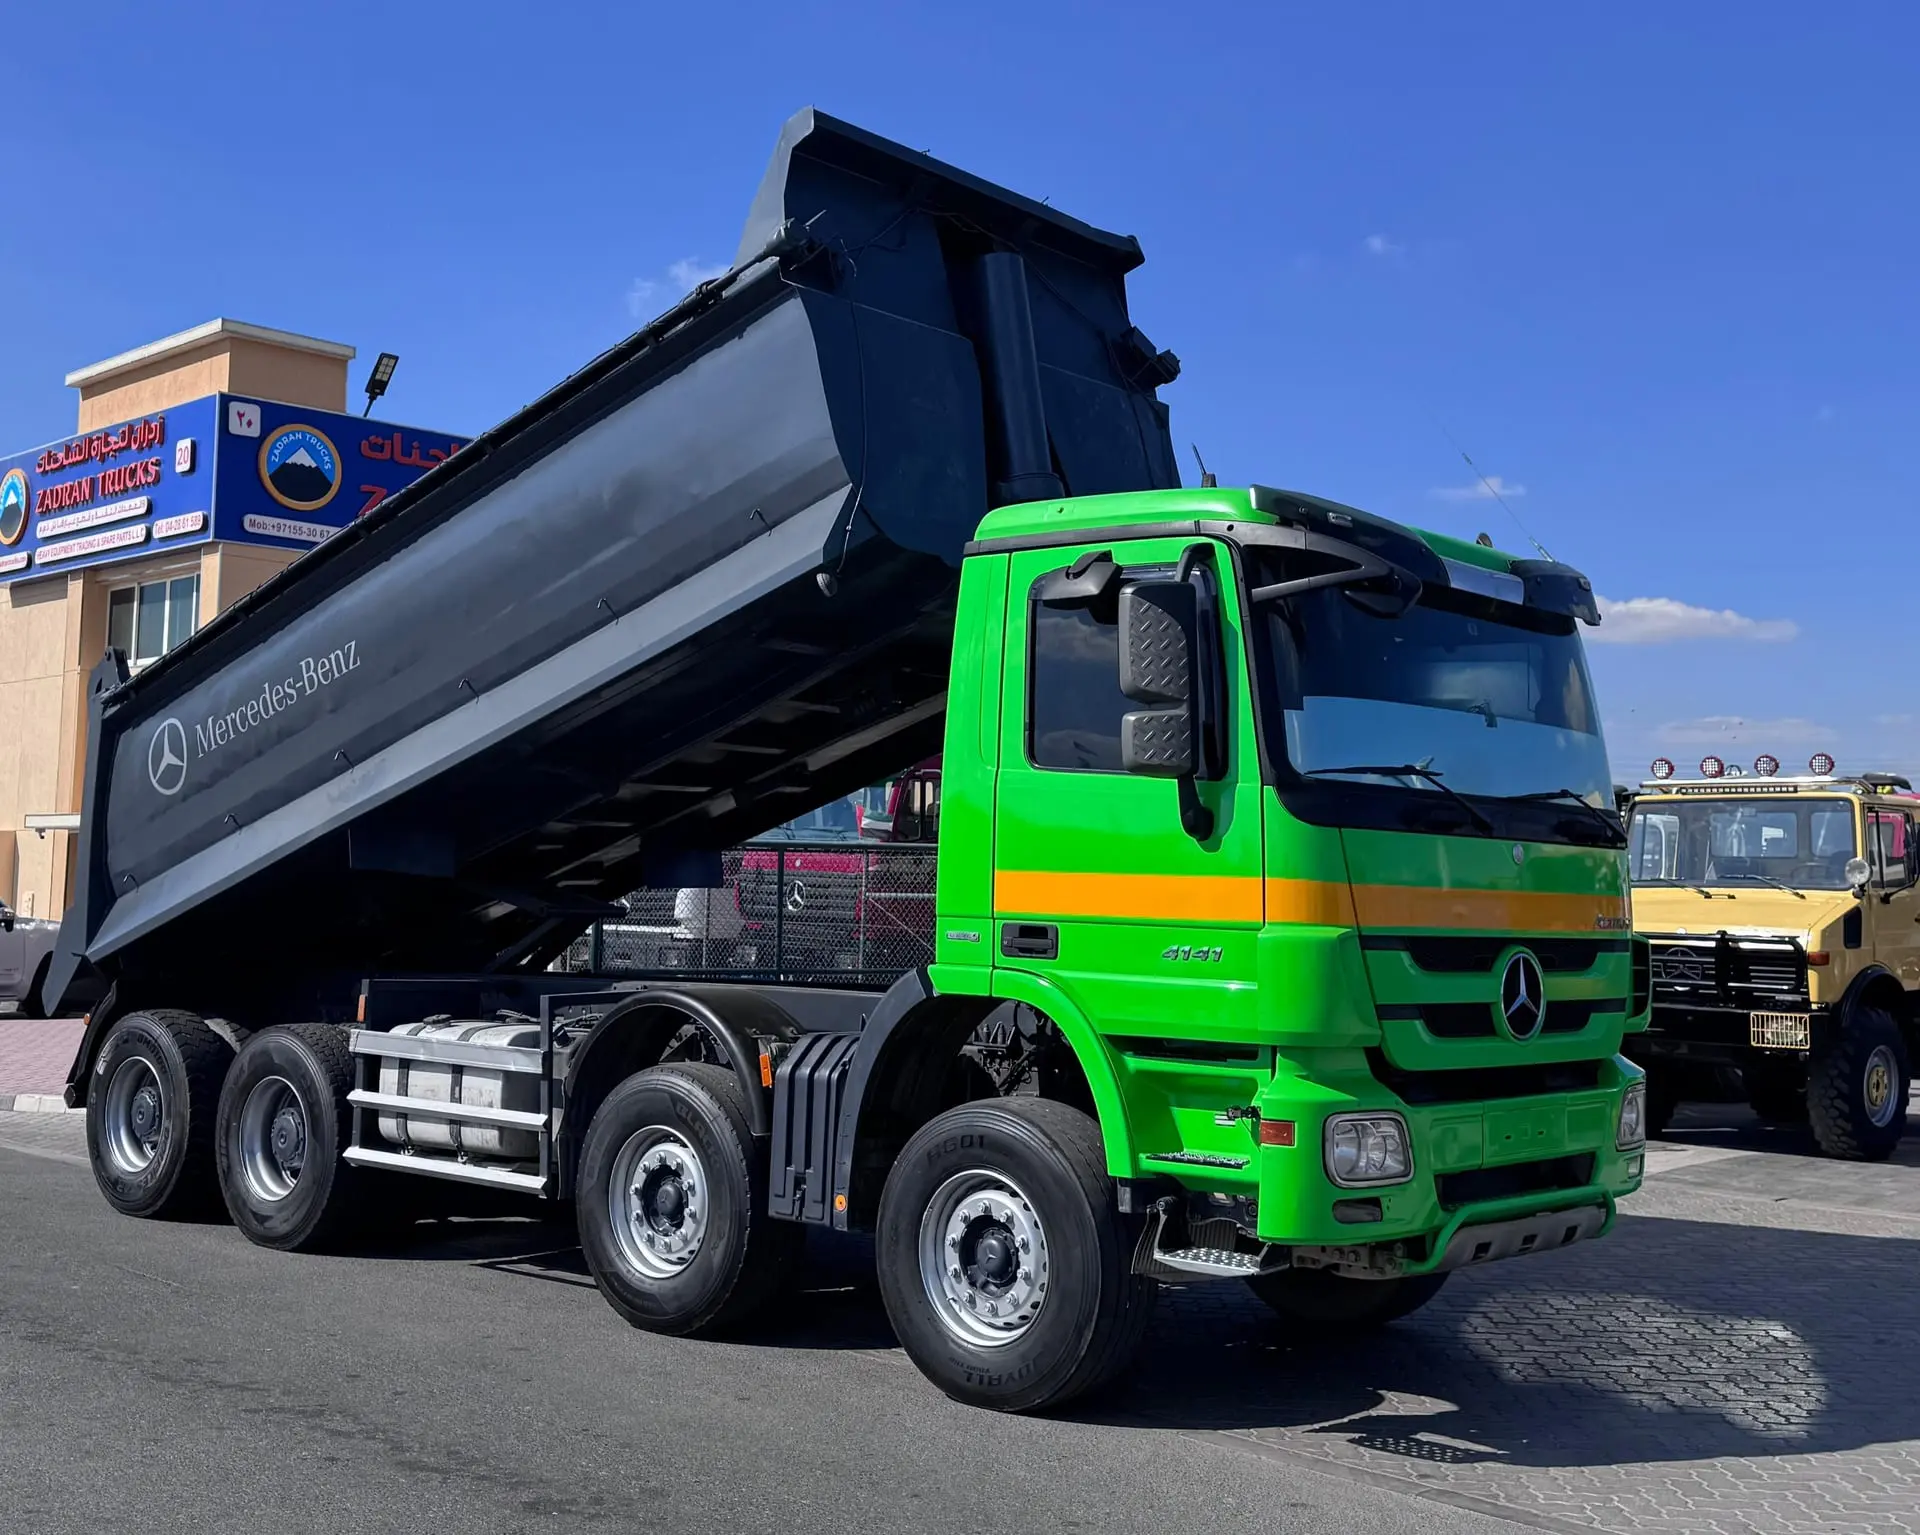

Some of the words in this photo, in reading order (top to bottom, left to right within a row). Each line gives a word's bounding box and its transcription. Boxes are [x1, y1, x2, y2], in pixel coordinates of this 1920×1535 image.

[236, 410, 253, 428] ٢٠
[177, 446, 189, 467] 20
[305, 432, 332, 470] TRUCKS
[35, 475, 94, 515] ZADRAN
[97, 456, 162, 496] TRUCKS
[195, 640, 361, 758] Mercedes-Benz
[1162, 945, 1223, 962] 4141
